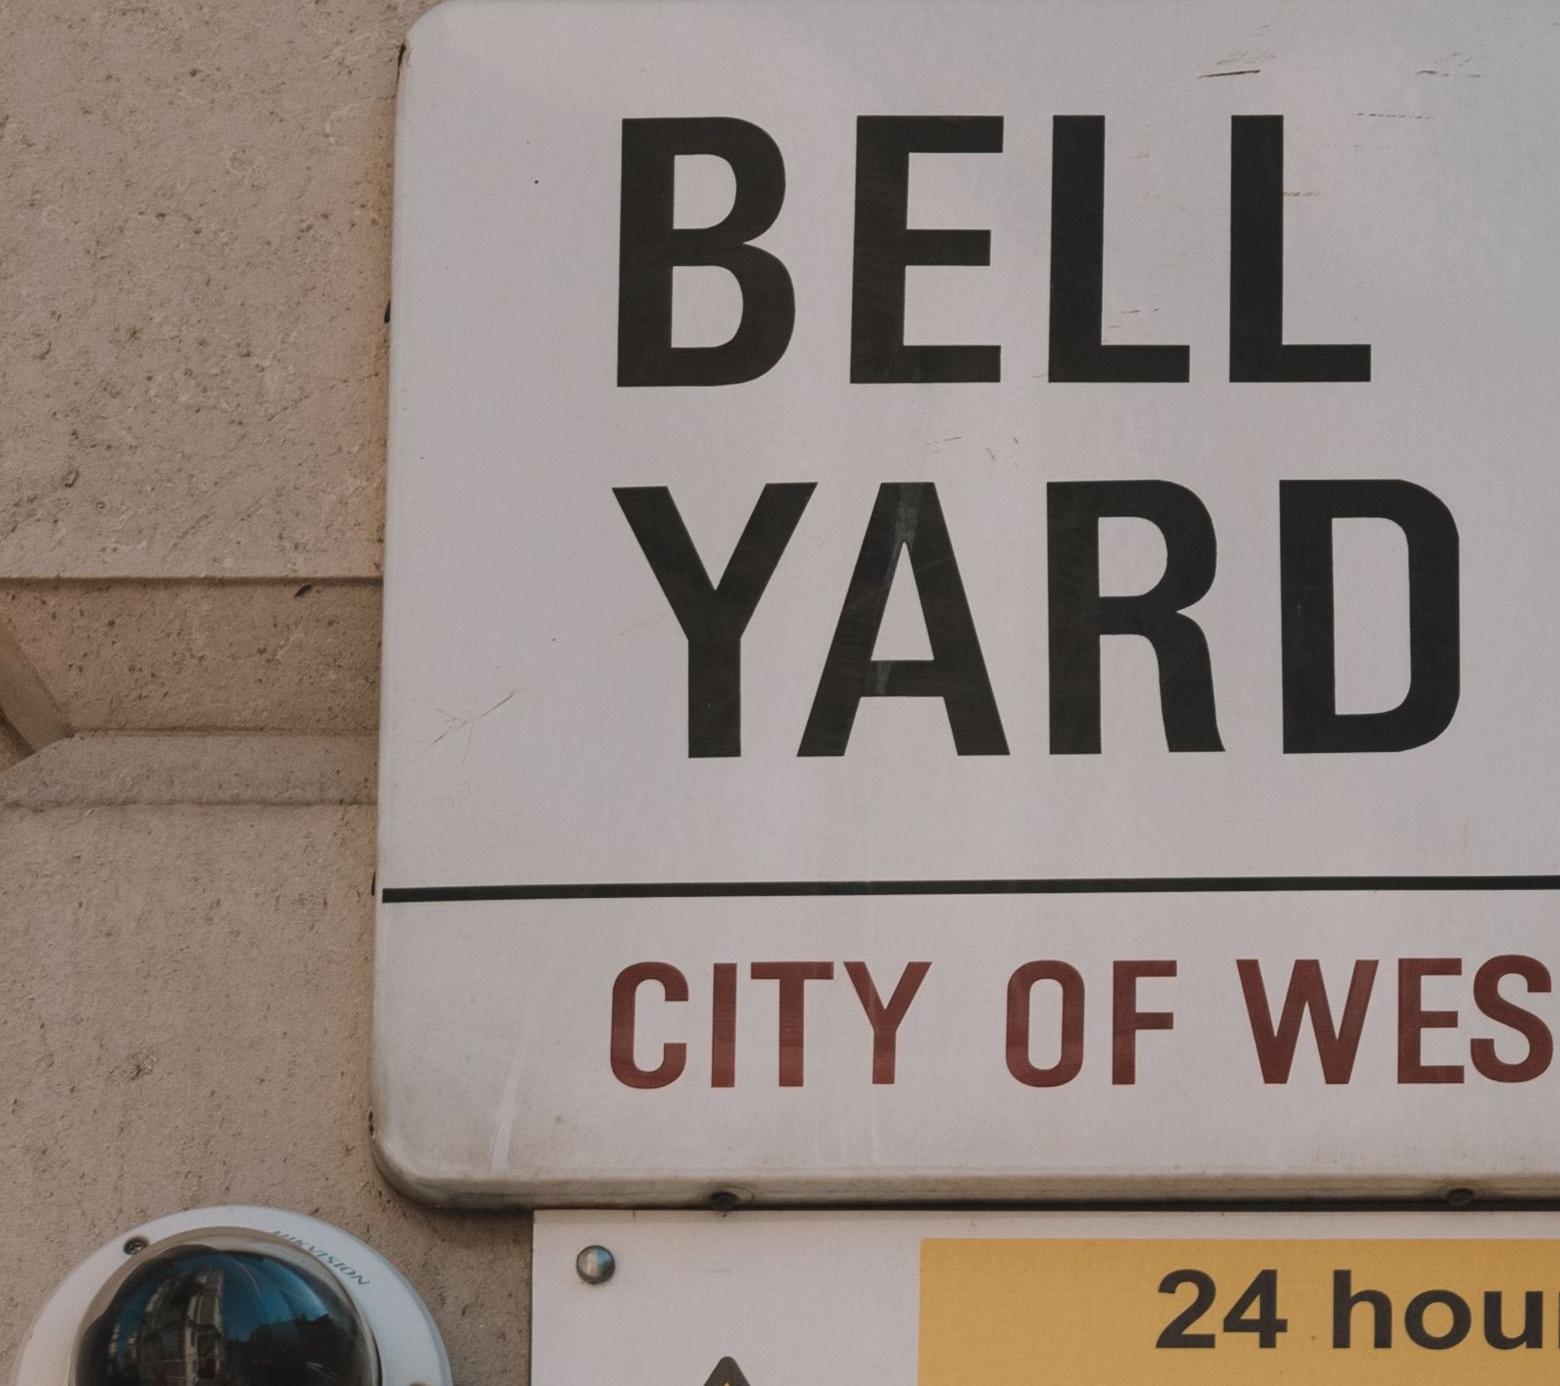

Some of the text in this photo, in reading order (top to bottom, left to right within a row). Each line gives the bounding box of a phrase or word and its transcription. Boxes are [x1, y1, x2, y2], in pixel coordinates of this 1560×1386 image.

[616, 114, 1372, 388] BELL
[611, 479, 1461, 759] YARD
[610, 961, 932, 1090] CITY
[1005, 959, 1177, 1088] OF
[1155, 1269, 1288, 1349] 24
